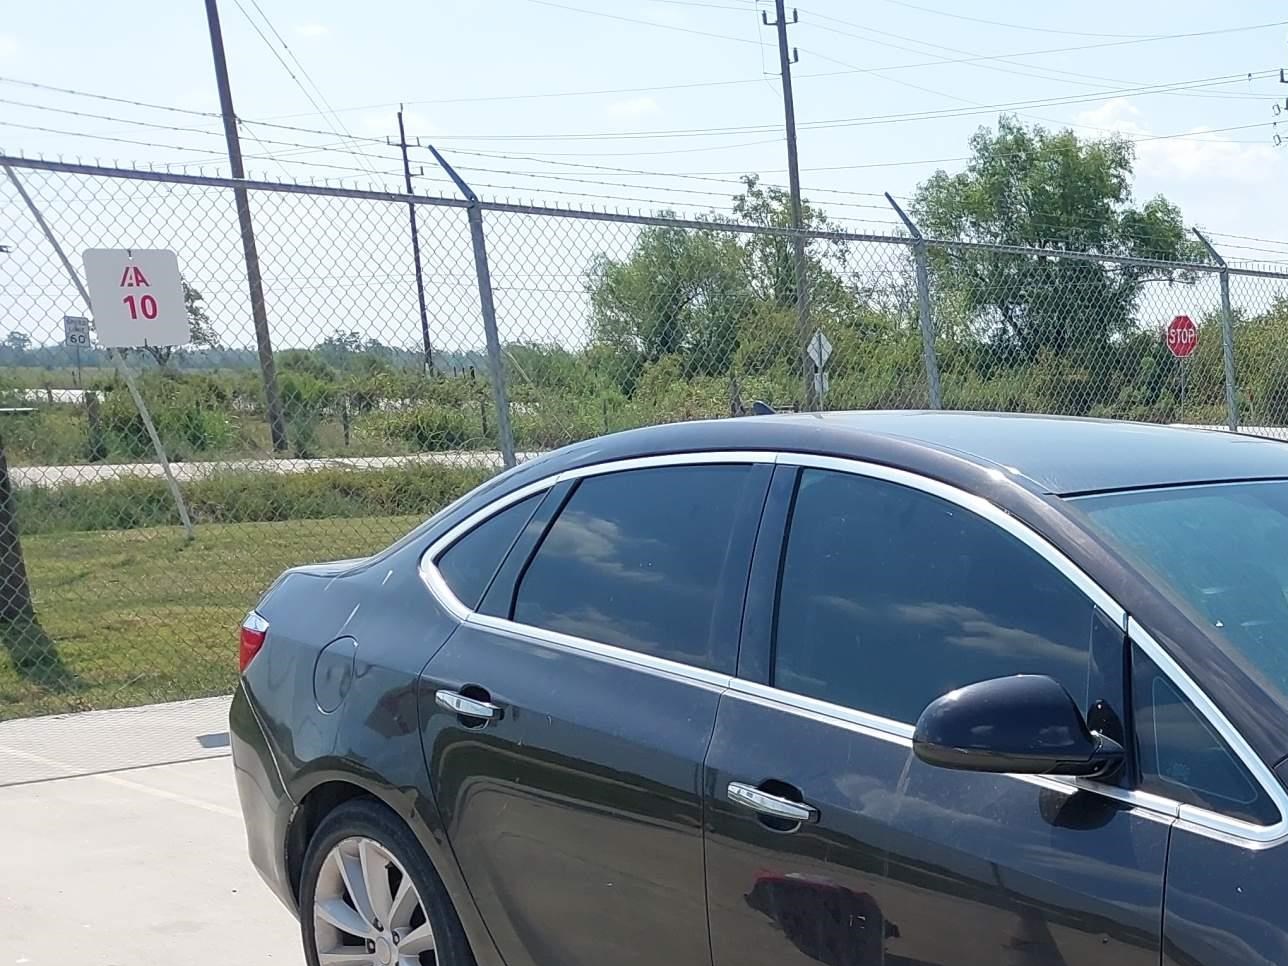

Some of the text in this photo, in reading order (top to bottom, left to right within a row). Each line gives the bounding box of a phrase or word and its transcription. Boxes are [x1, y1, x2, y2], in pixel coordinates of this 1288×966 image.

[123, 295, 158, 320] 10
[70, 334, 86, 344] 60
[1169, 328, 1195, 344] STOP
